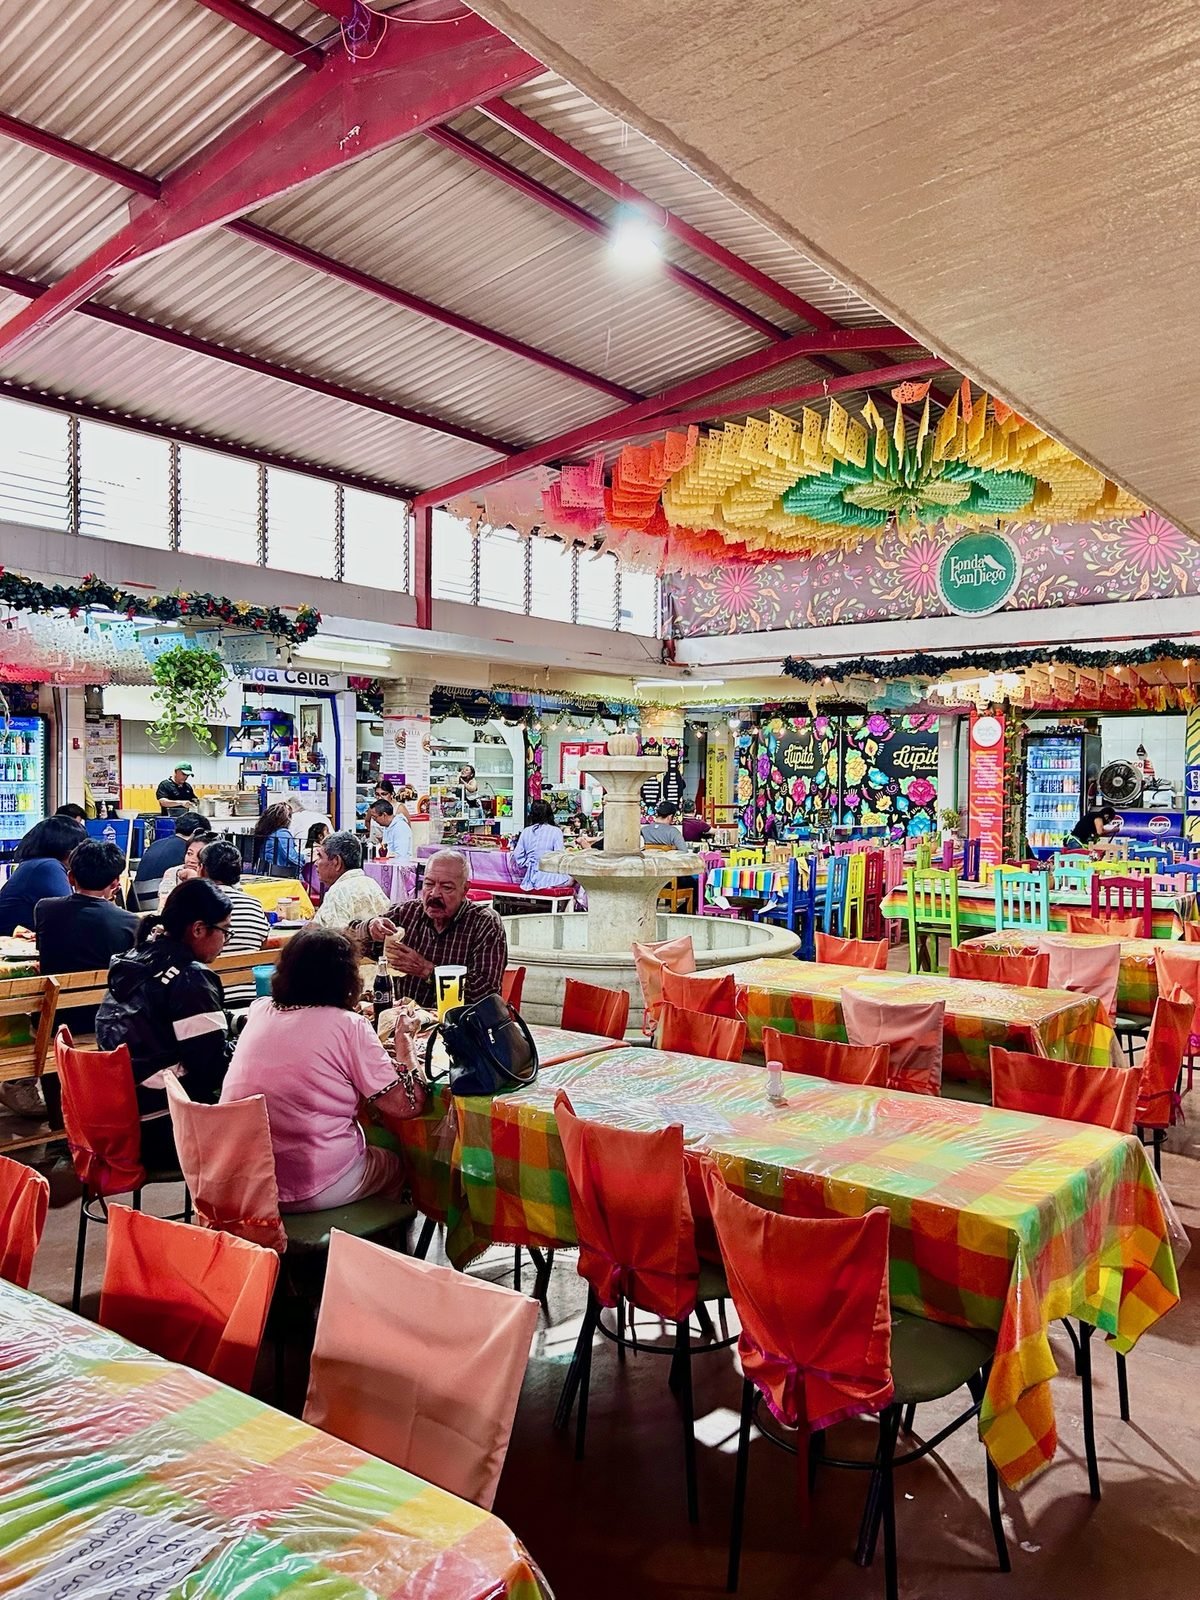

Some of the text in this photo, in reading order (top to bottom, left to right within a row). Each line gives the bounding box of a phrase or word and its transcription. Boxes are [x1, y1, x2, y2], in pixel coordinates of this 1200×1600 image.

[949, 553, 986, 582] Fonda
[783, 743, 815, 771] Lupita
[892, 744, 939, 772] Lupit
